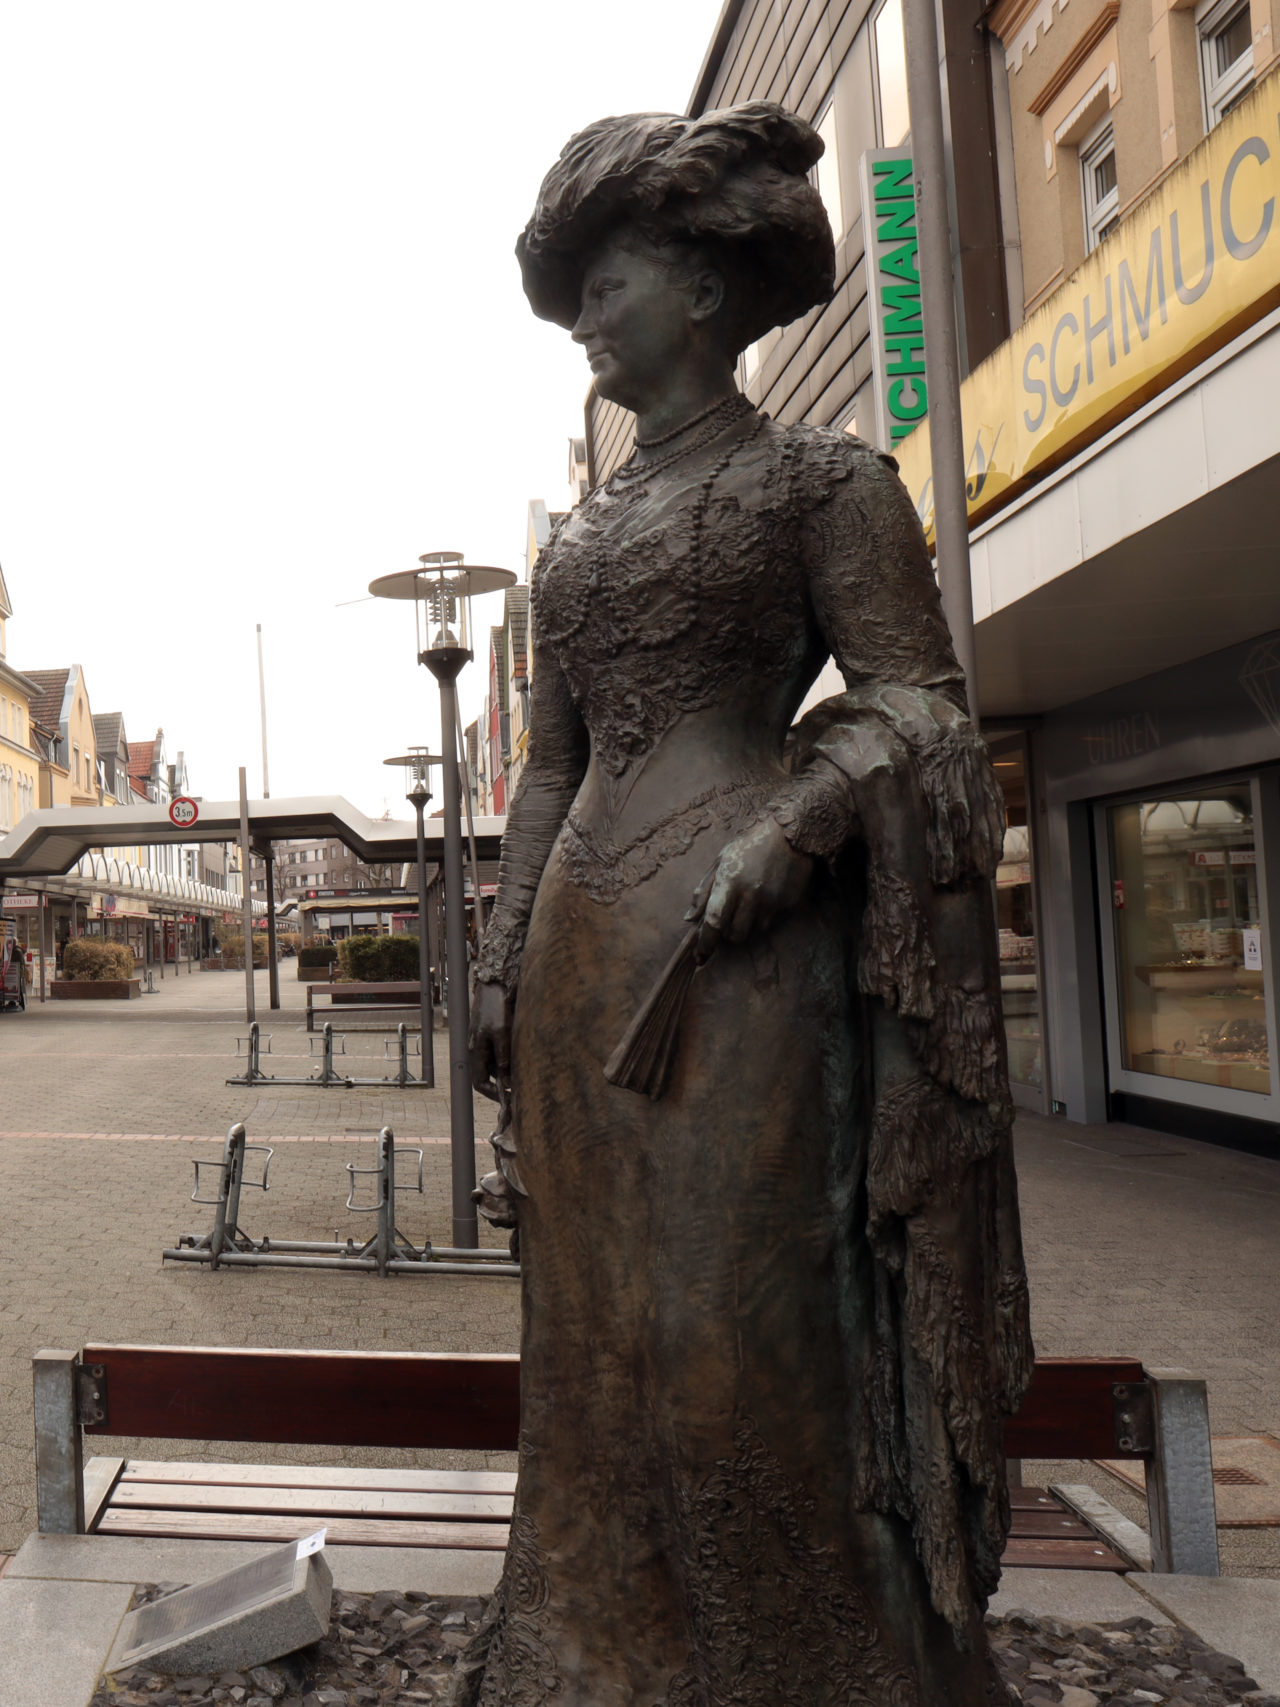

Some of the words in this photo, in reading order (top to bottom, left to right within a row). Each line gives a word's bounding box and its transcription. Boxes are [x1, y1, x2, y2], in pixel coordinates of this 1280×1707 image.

[872, 158, 928, 449] ICHMANN
[1023, 112, 1280, 433] SCHMUC
[1087, 708, 1161, 765] UHREN
